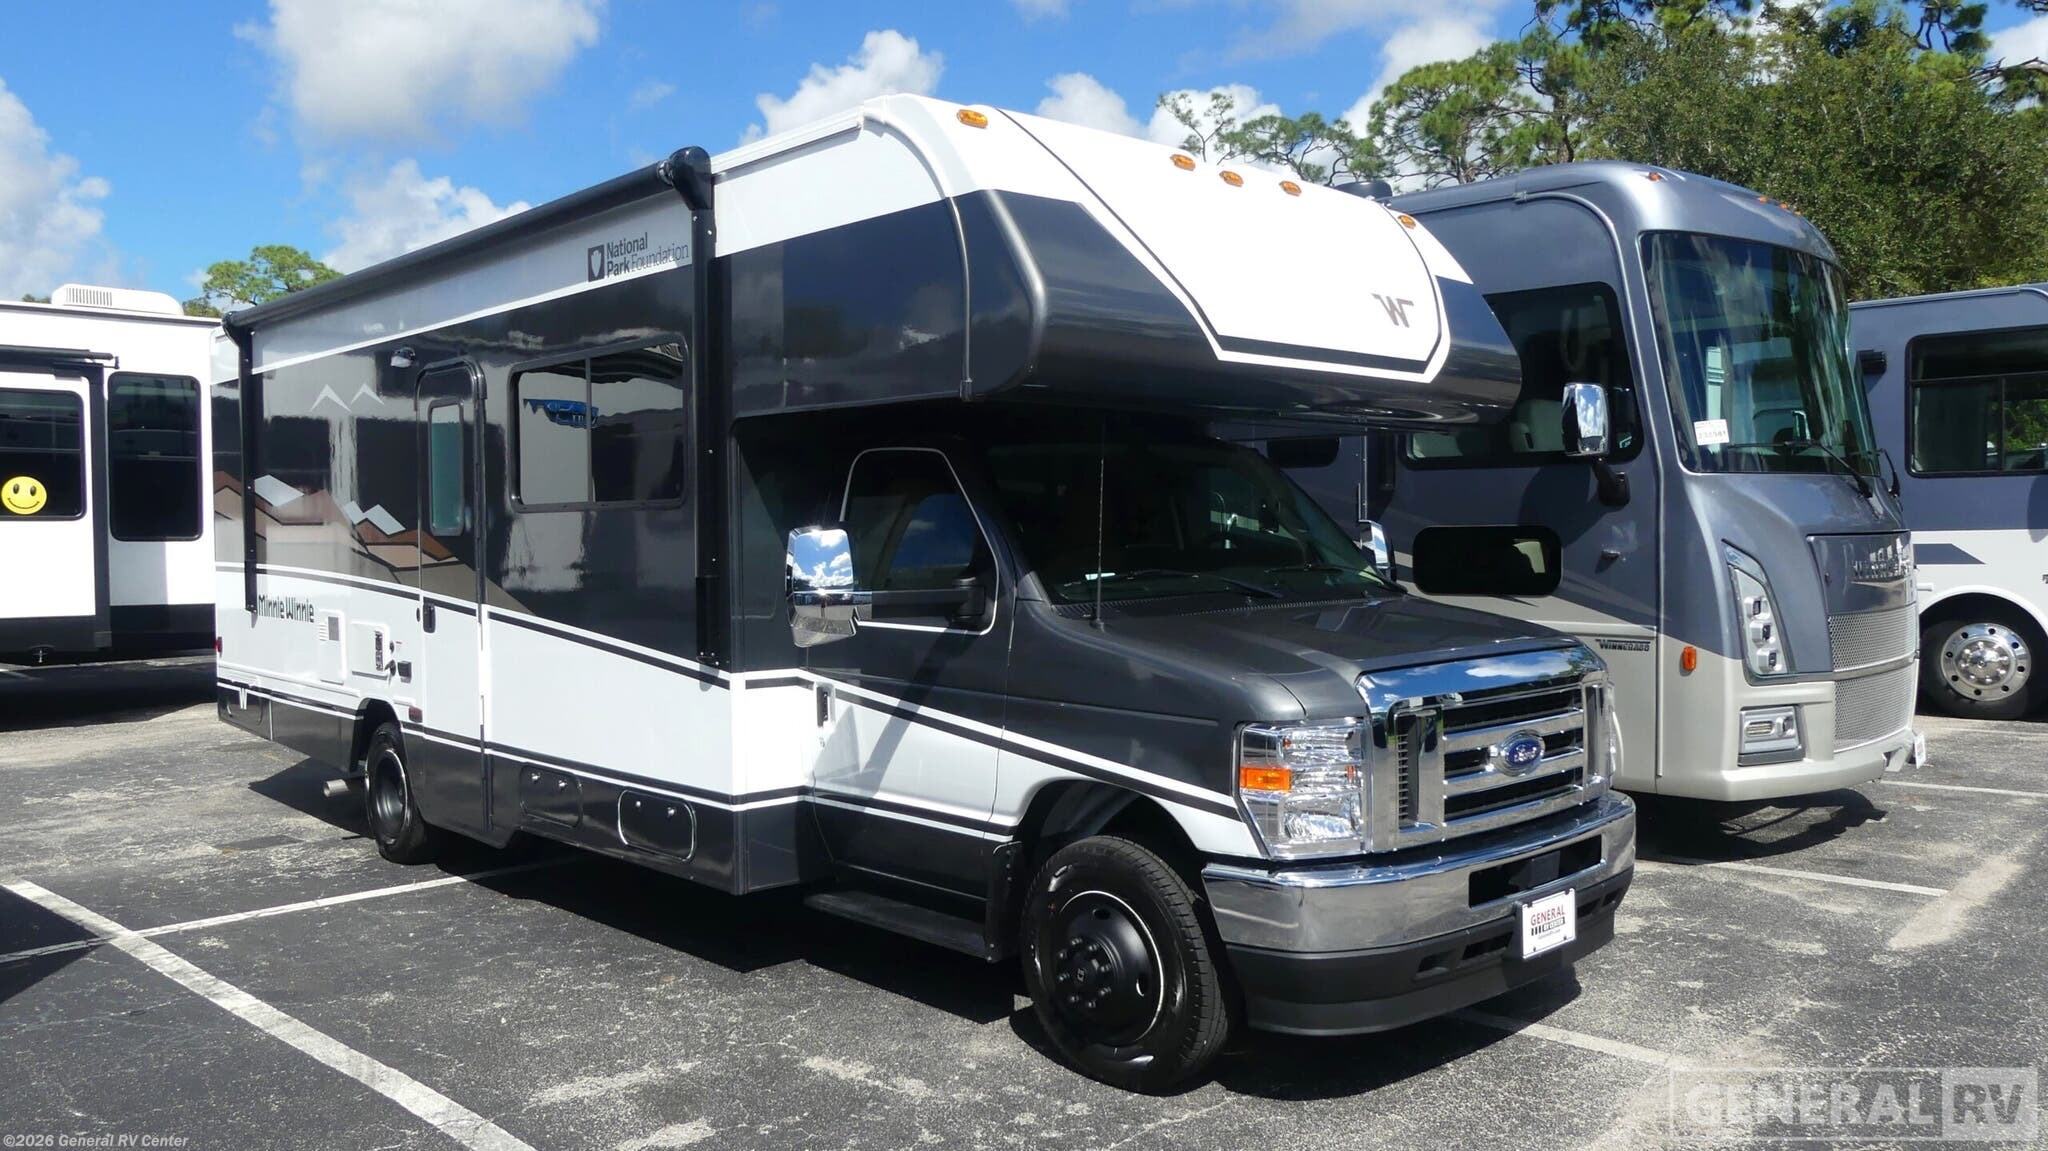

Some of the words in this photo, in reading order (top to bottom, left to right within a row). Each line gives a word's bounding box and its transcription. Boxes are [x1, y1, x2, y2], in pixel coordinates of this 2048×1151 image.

[606, 232, 648, 259] National
[606, 259, 630, 278] Park
[631, 242, 689, 273] Foundation
[258, 594, 284, 619] Minnie
[285, 596, 314, 623] Winnie
[1530, 904, 1565, 926] GENERAL
